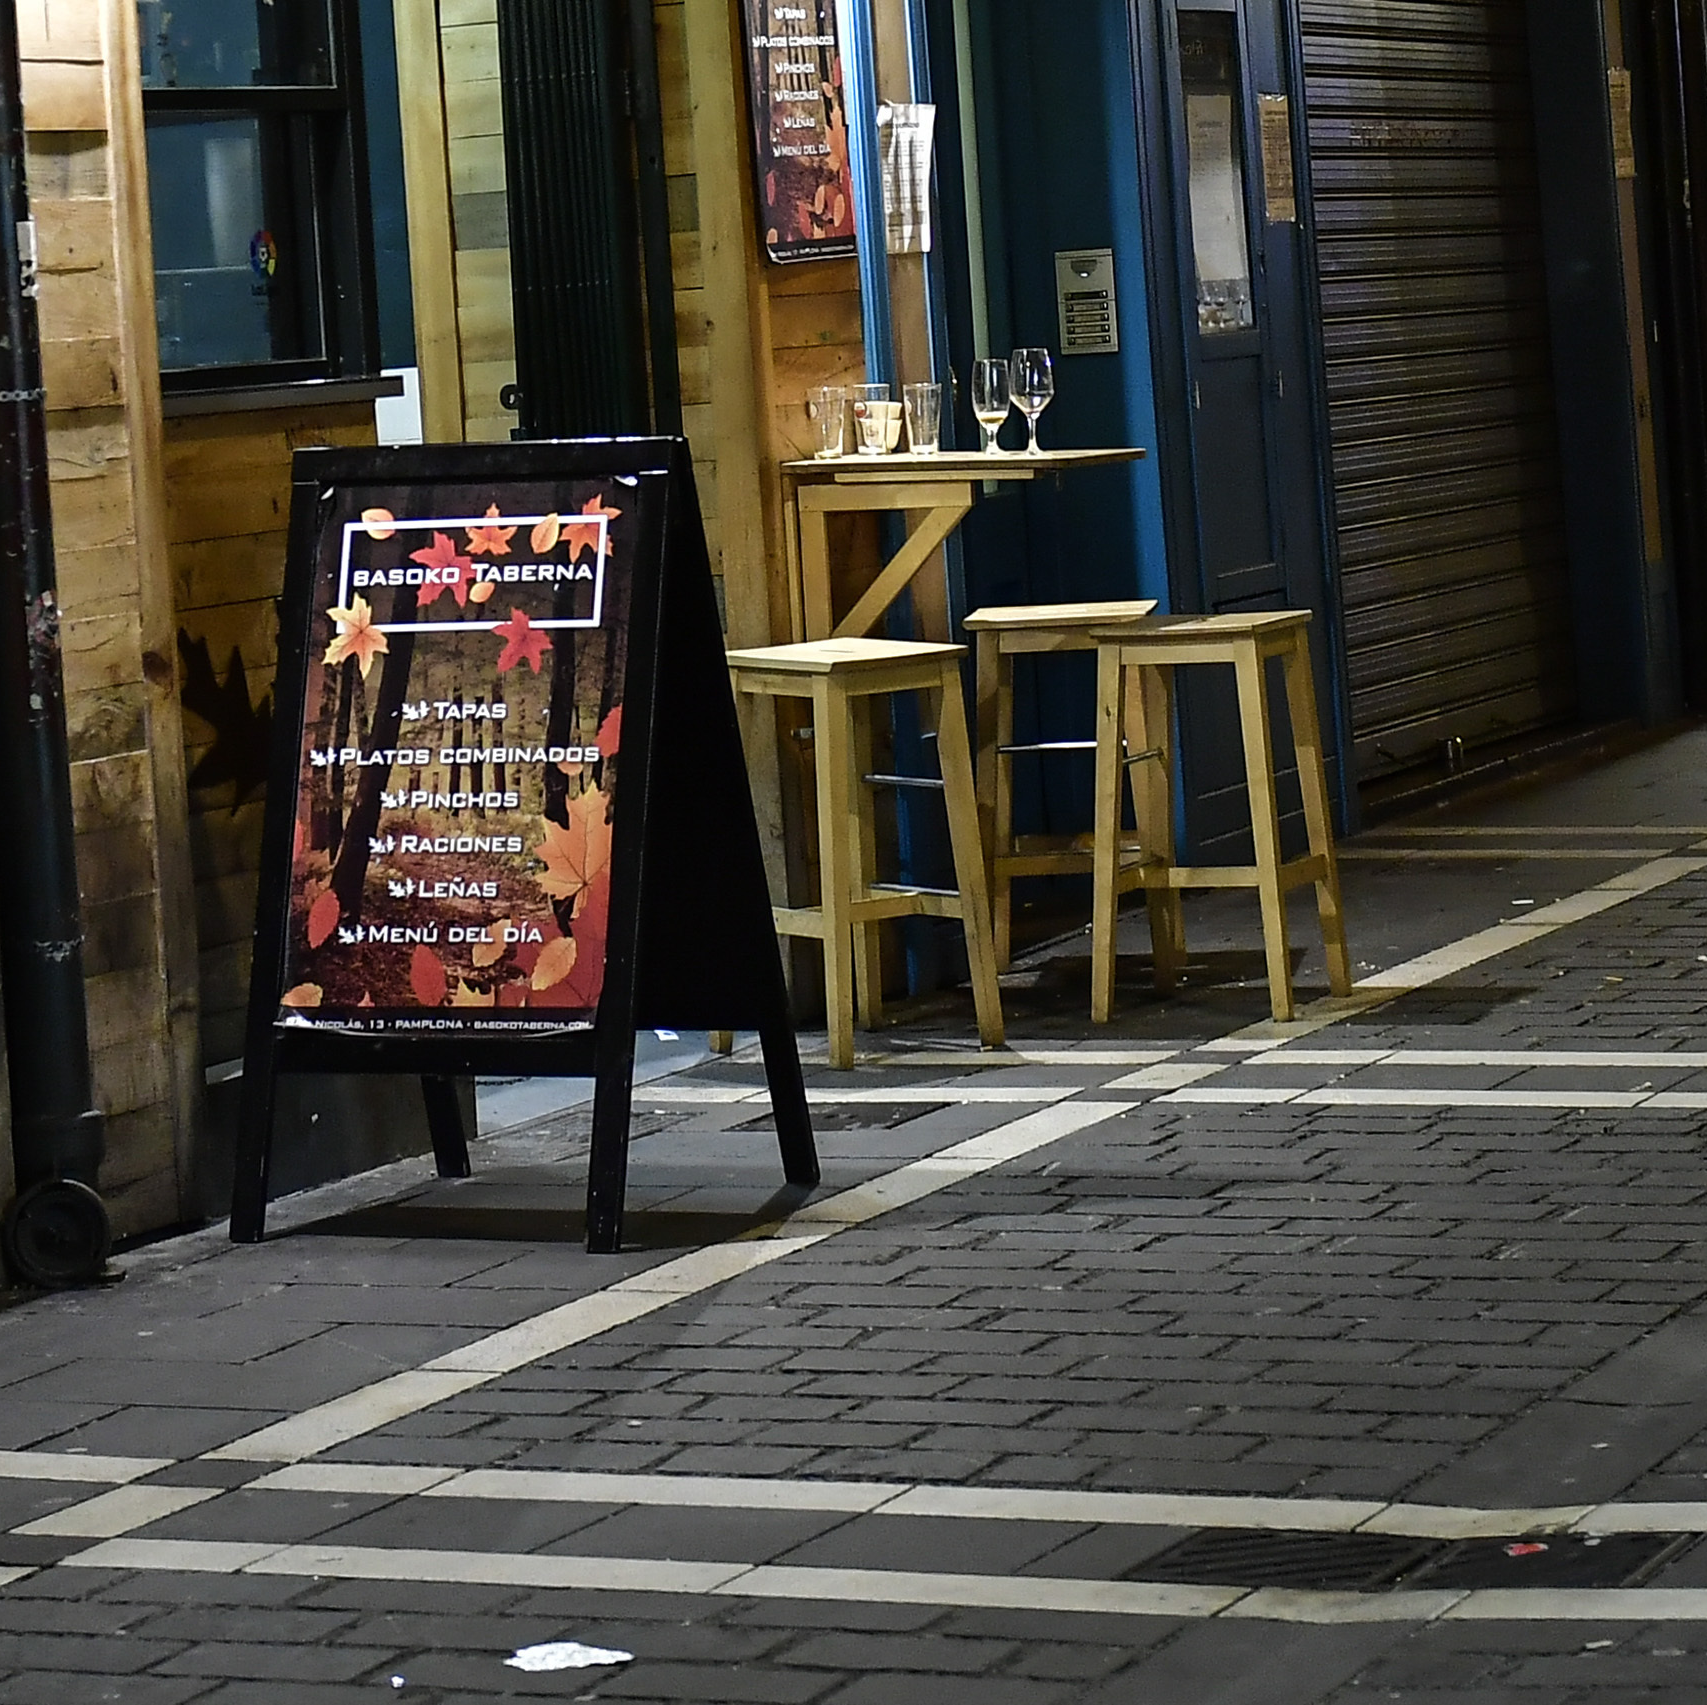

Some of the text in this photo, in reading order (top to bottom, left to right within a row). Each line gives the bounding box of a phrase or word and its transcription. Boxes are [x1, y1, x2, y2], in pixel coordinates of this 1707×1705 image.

[353, 562, 594, 588] BASOKO TABERNA
[433, 701, 507, 720] TAPAS
[338, 745, 600, 767] PLATOS COMBINADOS
[410, 790, 519, 810] PINCHOS
[399, 835, 523, 855] RACIONES
[418, 876, 498, 899] LEÑAS
[367, 919, 543, 944] MENÚ DEL DÍA
[369, 1019, 385, 1030] 13
[394, 1019, 464, 1030] PAMPLONA
